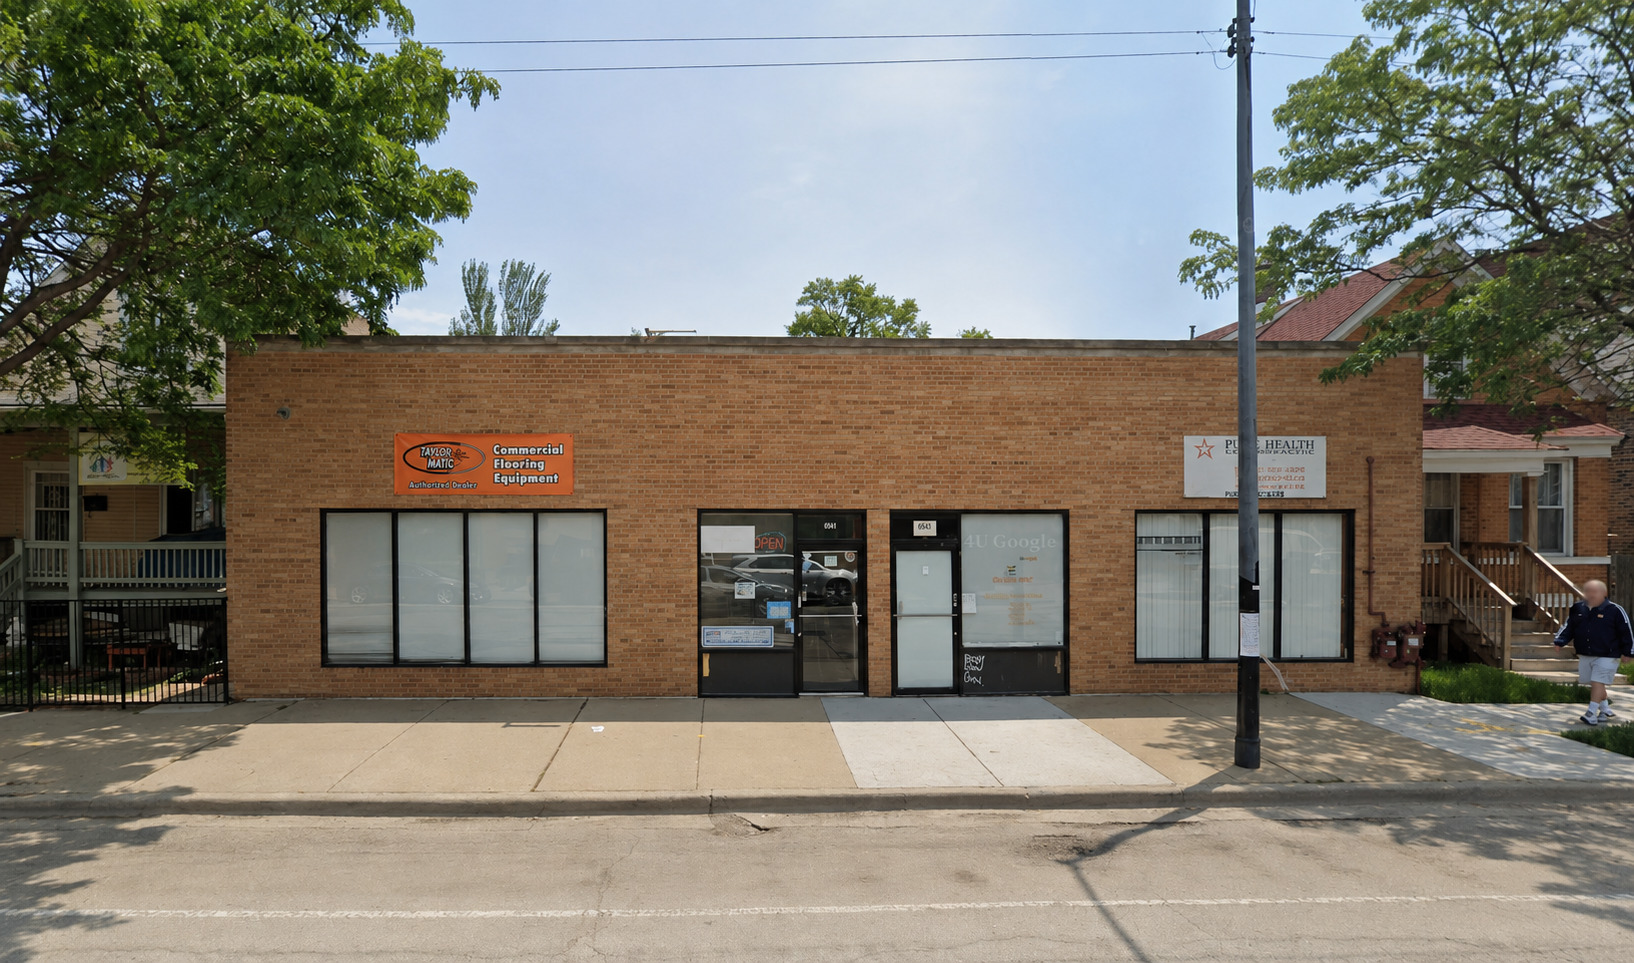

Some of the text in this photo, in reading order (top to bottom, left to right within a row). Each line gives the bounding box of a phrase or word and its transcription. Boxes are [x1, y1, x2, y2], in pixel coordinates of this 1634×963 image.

[493, 444, 563, 455] Commercial
[1265, 439, 1315, 449] HEALTH
[420, 446, 452, 457] TAYLOR
[427, 458, 454, 469] MATIC
[493, 459, 545, 471] Flooring
[408, 481, 478, 489] Authorized Dealer
[493, 473, 559, 486] Equipment
[754, 537, 784, 550] OPEN
[963, 534, 1057, 553] 4U Google
